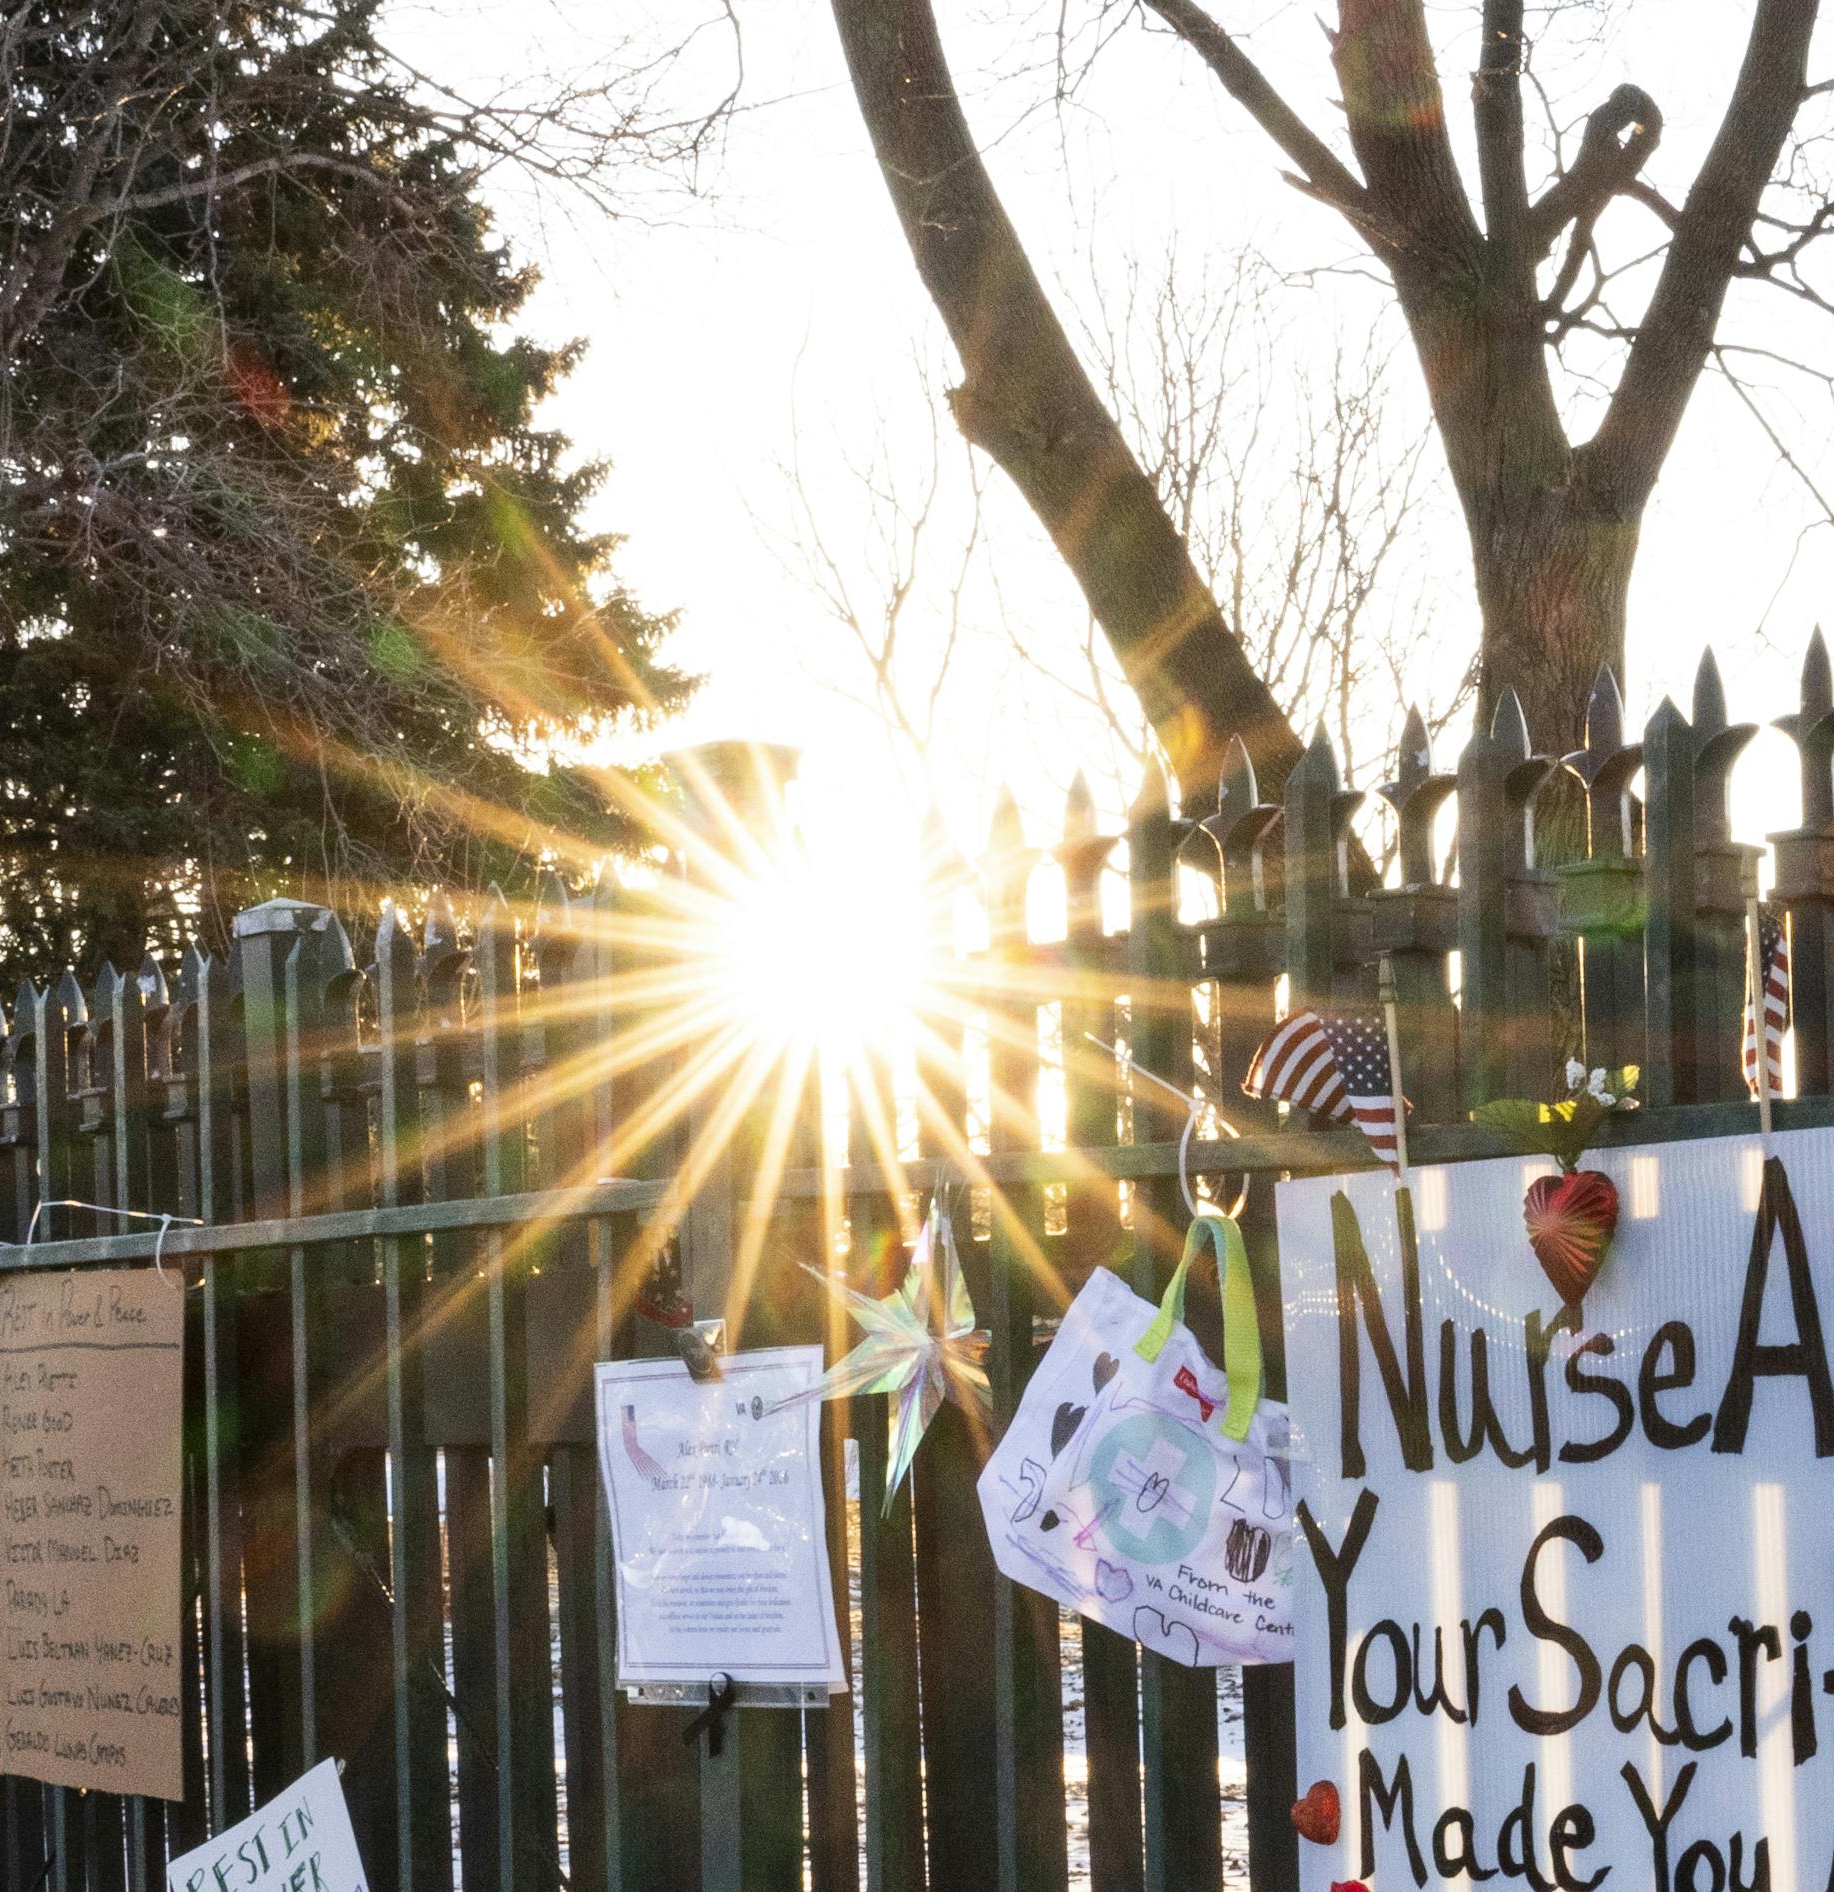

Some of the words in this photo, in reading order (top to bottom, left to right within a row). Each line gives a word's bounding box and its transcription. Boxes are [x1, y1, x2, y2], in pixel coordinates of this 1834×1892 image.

[61, 1278, 90, 1327] Power
[110, 1285, 147, 1323] Peace
[1331, 1183, 1714, 1479] Nurse
[1146, 1574, 1162, 1590] VA
[1168, 1585, 1244, 1624] Childcare
[1178, 1564, 1229, 1596] From
[1244, 1591, 1275, 1610] the
[1296, 1488, 1506, 1730] Your
[277, 1797, 315, 1859] IN
